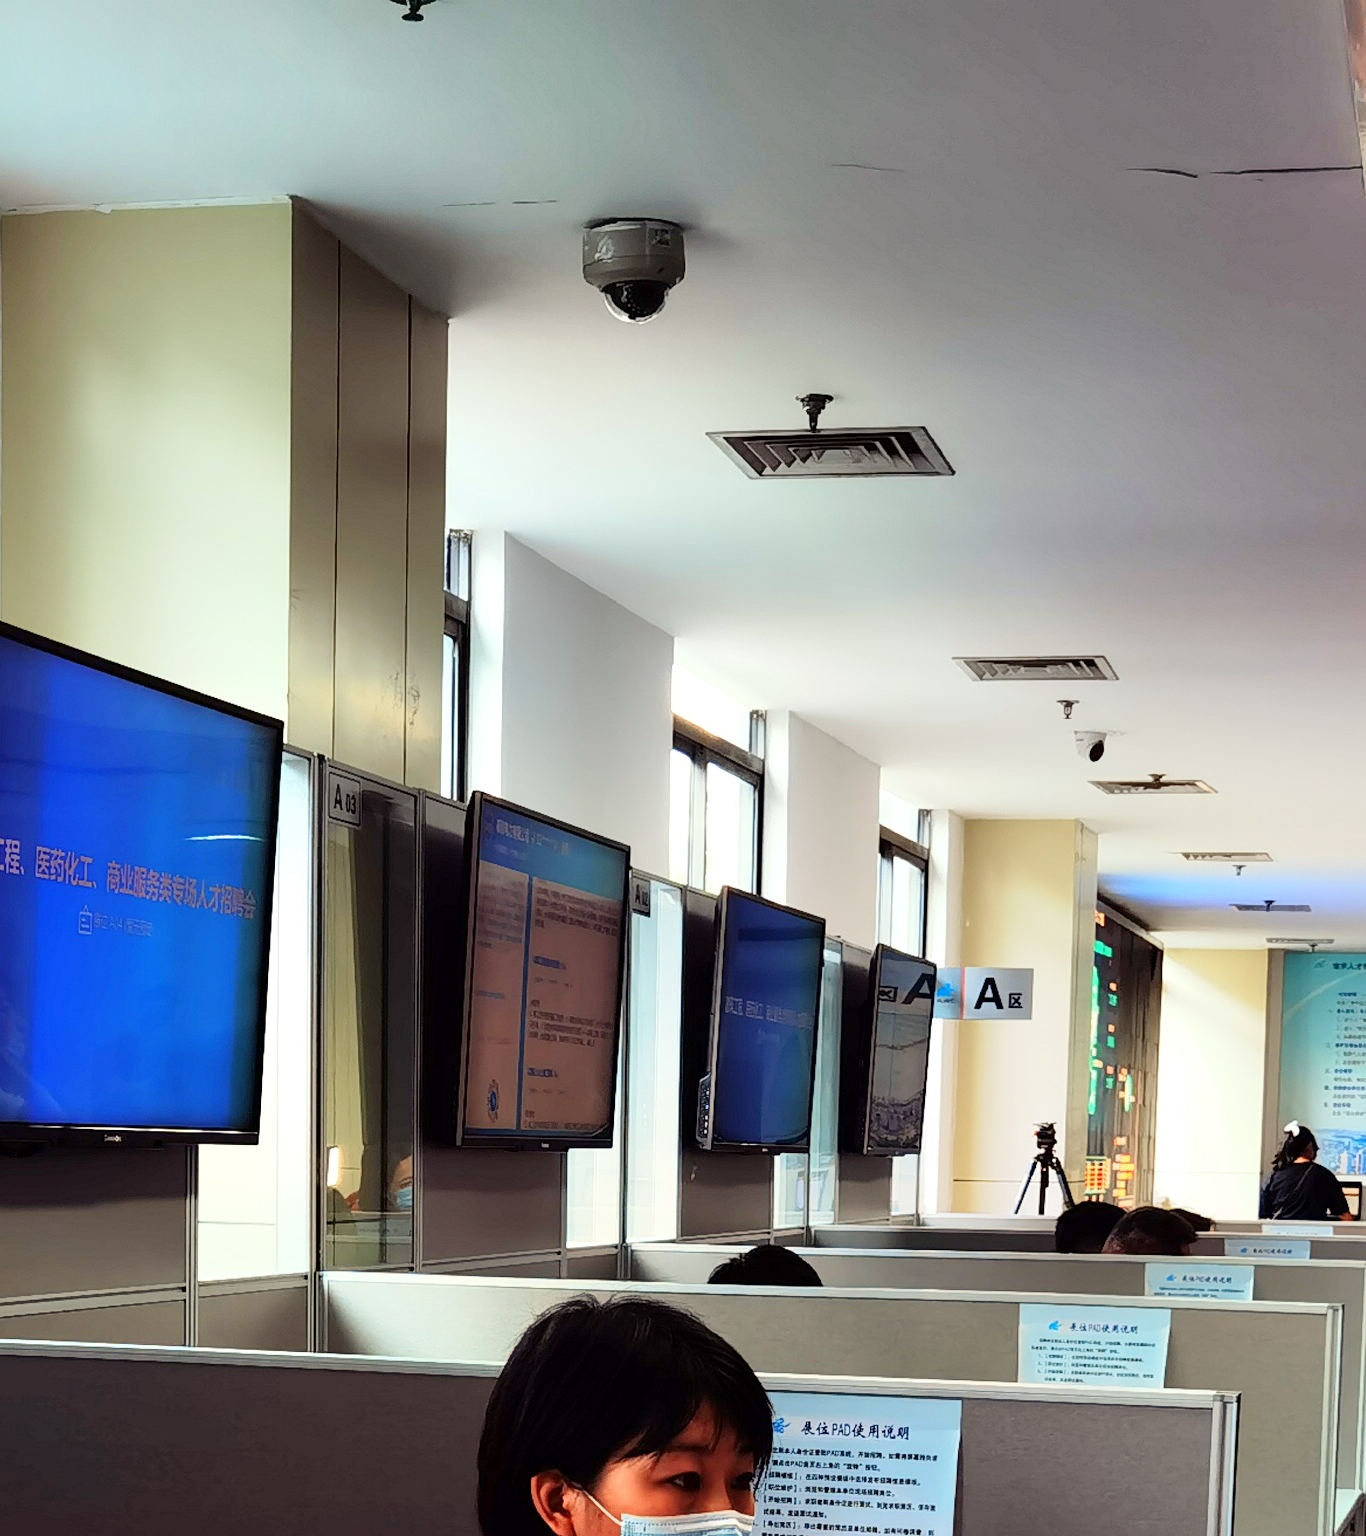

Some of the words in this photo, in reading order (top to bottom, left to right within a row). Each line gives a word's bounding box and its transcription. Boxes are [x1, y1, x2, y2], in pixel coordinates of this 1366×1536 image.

[334, 784, 344, 811] A
[345, 795, 356, 815] 03
[800, 1421, 910, 1442] 展位PAD使用说明
